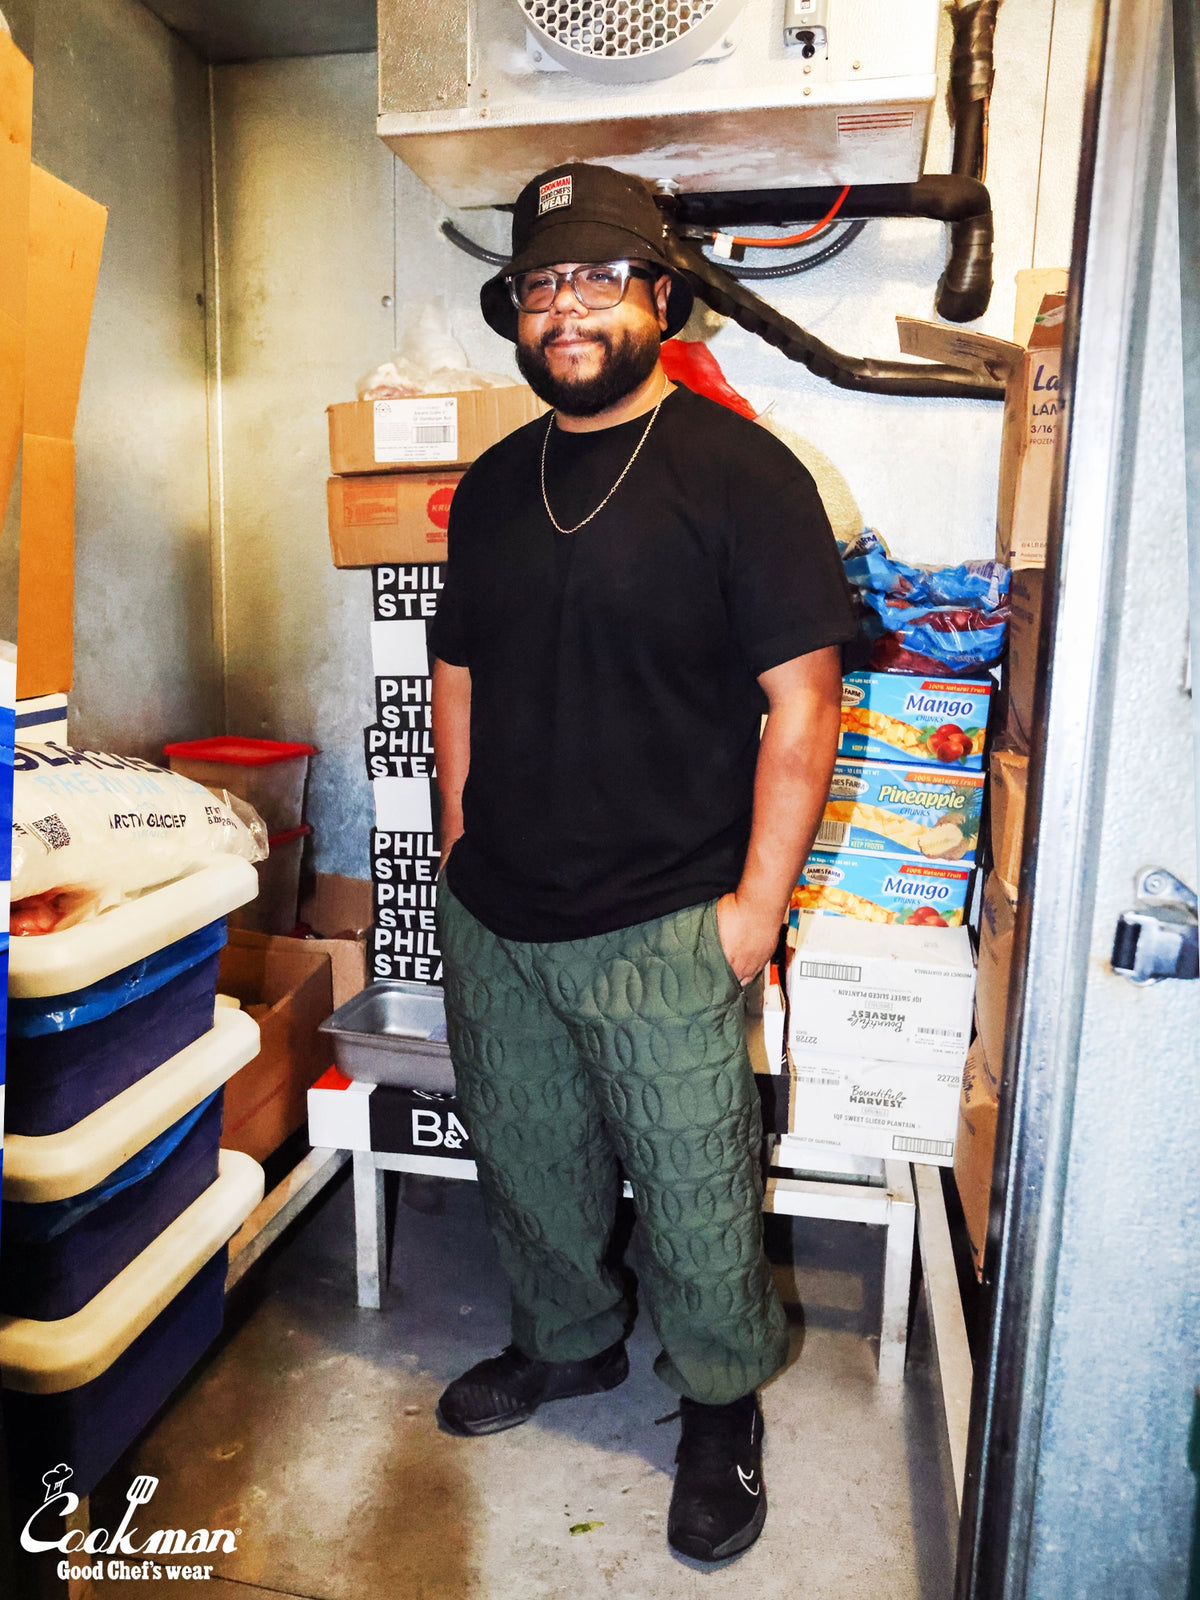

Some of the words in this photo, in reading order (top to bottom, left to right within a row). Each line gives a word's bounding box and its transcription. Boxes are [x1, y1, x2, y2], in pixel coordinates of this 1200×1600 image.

[541, 177, 571, 195] COOKMAN
[541, 194, 569, 211] WEAR
[377, 566, 445, 590] PHIL
[378, 593, 438, 617] STE
[906, 694, 973, 717] Mango
[878, 785, 966, 810] Pineapple
[146, 812, 187, 829] GLACIER
[374, 833, 442, 857] PHIL
[922, 869, 946, 877] Natural
[946, 871, 962, 879] Fruit
[884, 878, 949, 900] Mango
[378, 908, 437, 931] STE
[374, 928, 442, 956] PHIL
[838, 988, 868, 999] PLANTAIN
[868, 991, 890, 1001] SLICED
[890, 993, 911, 1002] SWEET
[851, 1010, 906, 1022] HARVEST
[937, 1073, 960, 1083] 22728
[849, 1095, 902, 1109] HARVEST
[844, 1114, 864, 1123] SWEET
[865, 1117, 886, 1126] SLICED
[886, 1119, 916, 1129] PLANTAIN
